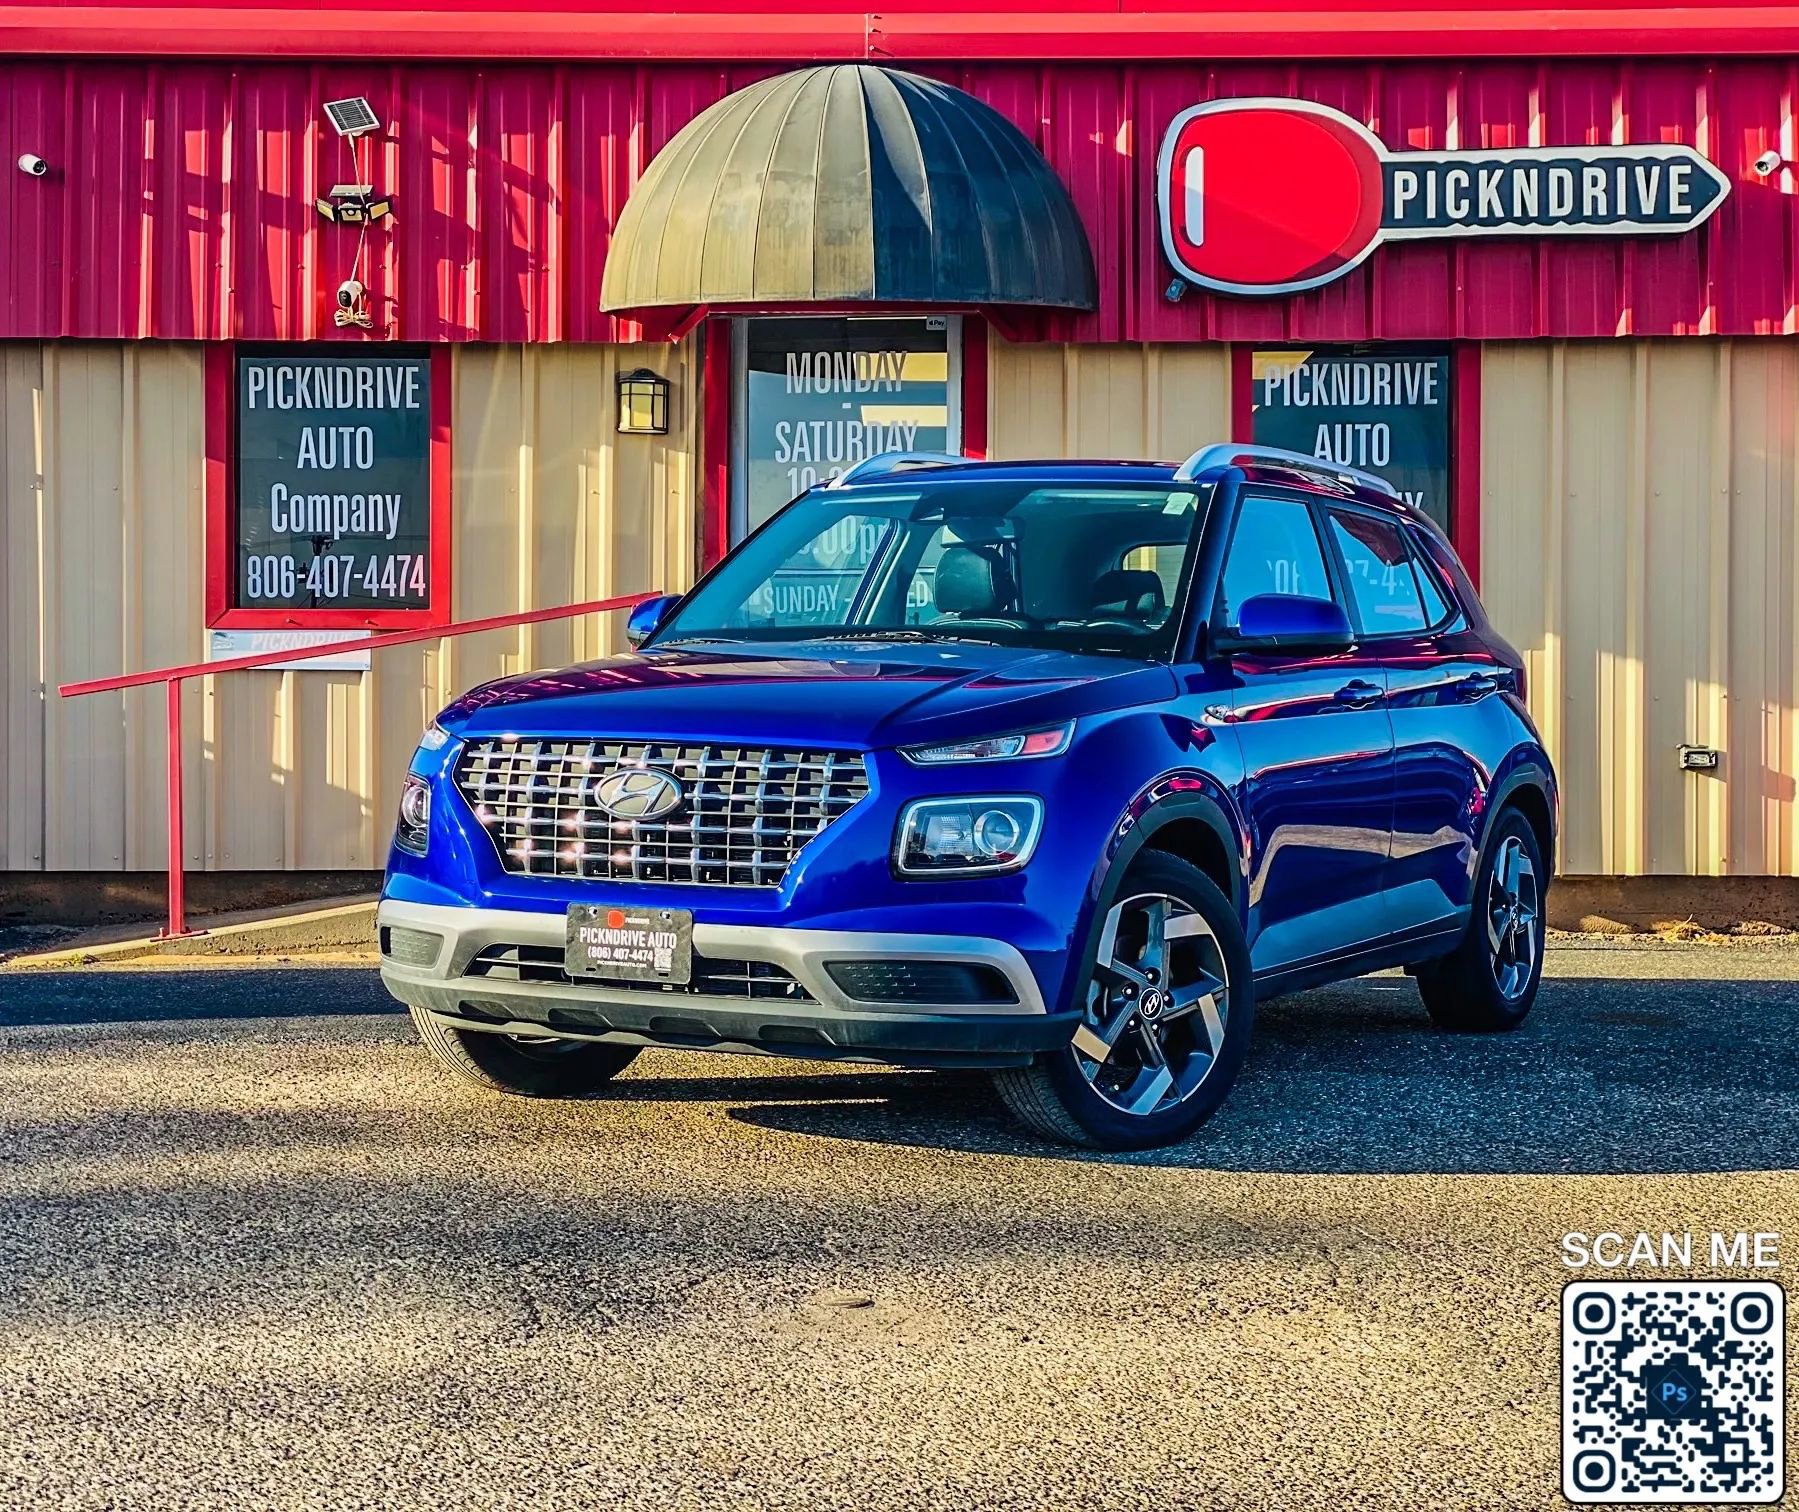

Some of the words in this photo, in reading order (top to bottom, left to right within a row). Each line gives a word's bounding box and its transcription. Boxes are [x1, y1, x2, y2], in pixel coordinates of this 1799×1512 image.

[1393, 164, 1693, 220] PICKNDRIVE
[248, 366, 421, 410] PICKNDRIVE
[785, 350, 907, 394] MONDAY
[1264, 362, 1439, 407] PICKNDRIVE
[297, 426, 374, 470] AUTO
[775, 420, 918, 463] SATURDAY
[1313, 422, 1391, 467] AUTO
[271, 483, 401, 540] Company
[247, 554, 426, 599] 806-407-4474
[763, 584, 839, 614] SUNDAY
[579, 927, 646, 947] PICKNDRIVE
[647, 931, 677, 949] AUTO
[587, 945, 612, 960] (806)
[612, 947, 654, 962] 407-4474
